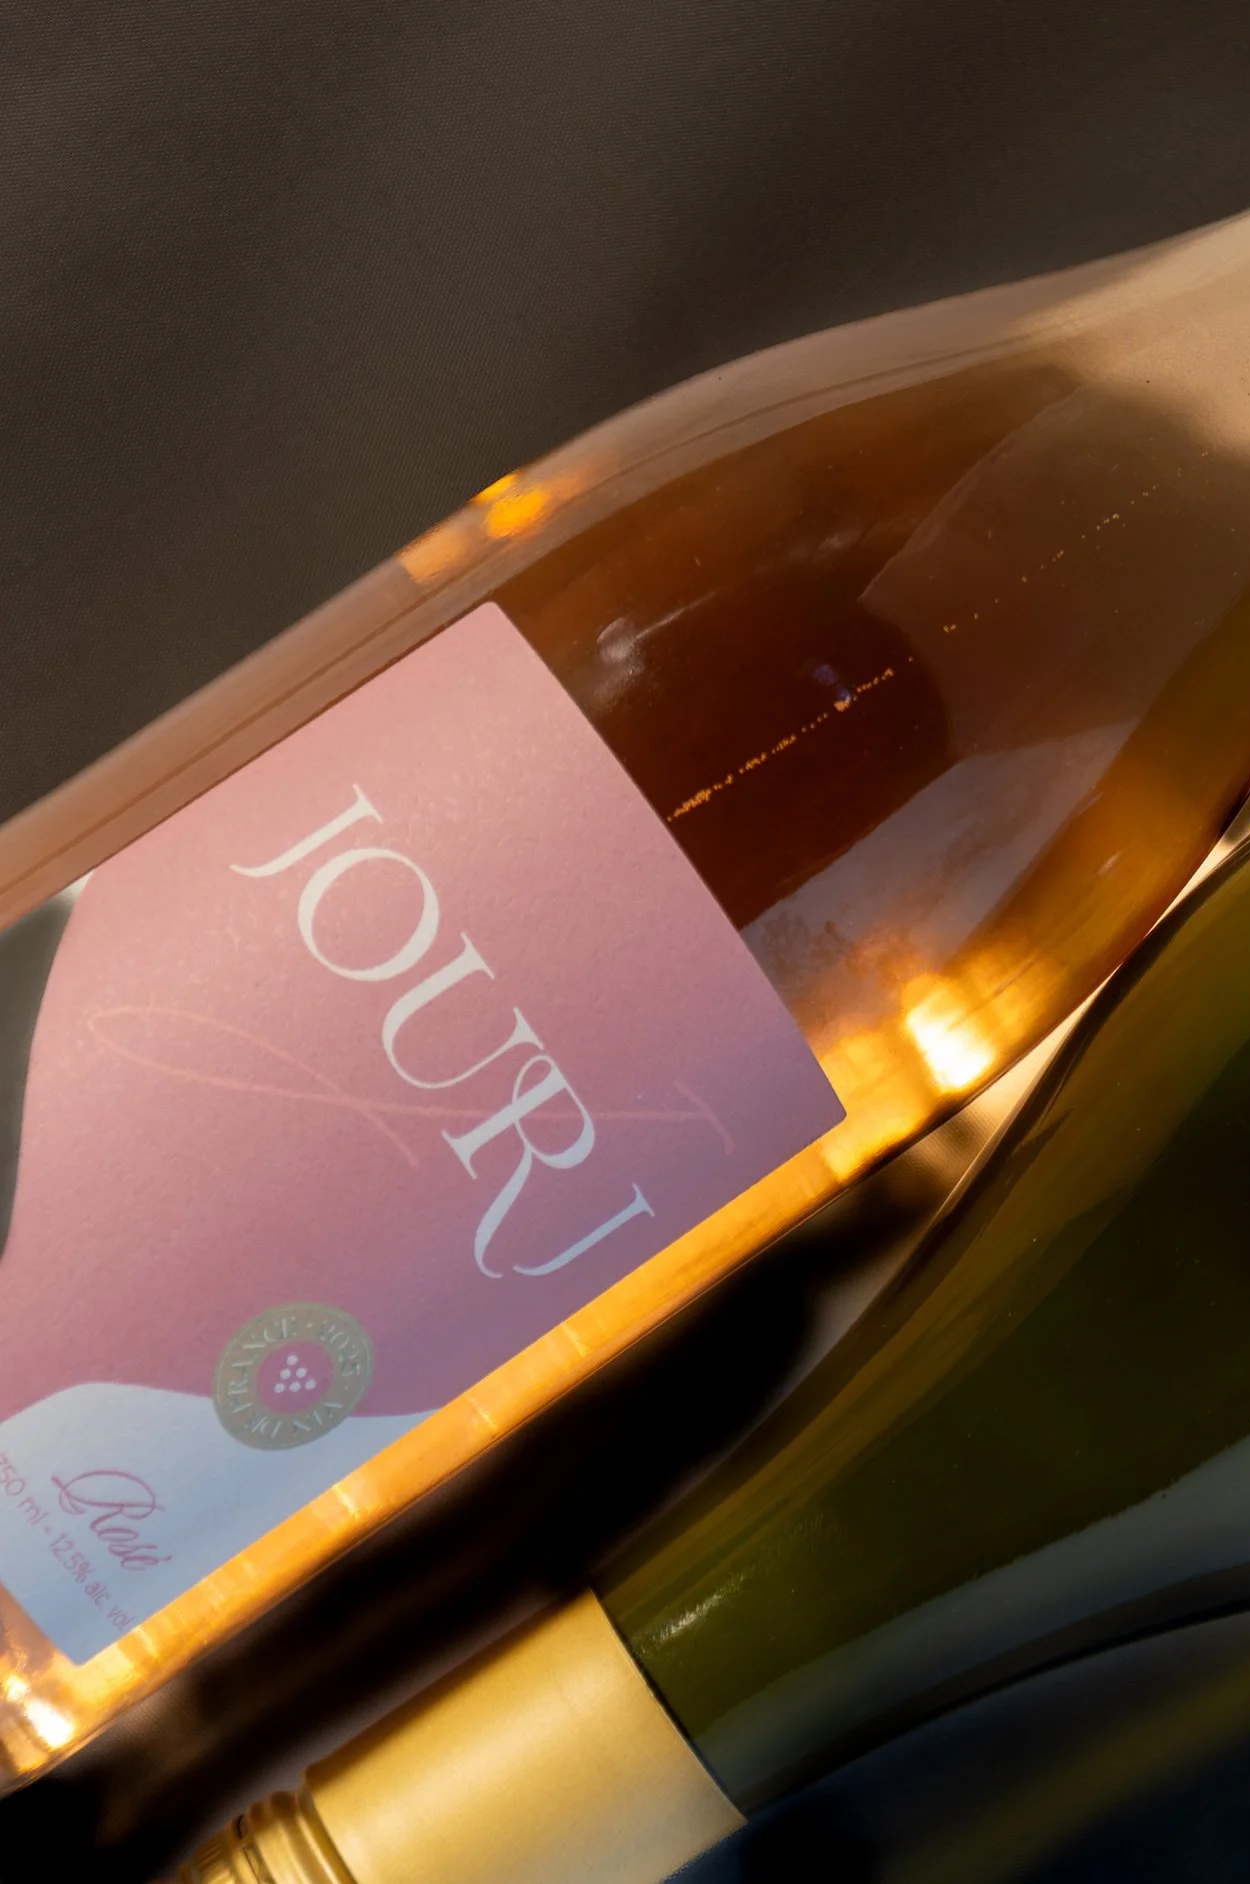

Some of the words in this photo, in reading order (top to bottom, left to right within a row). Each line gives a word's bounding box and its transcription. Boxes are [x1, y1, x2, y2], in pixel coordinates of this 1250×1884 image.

[227, 1316, 297, 1414] FRANCE
[293, 1402, 343, 1436] VIN
[17, 1497, 49, 1526] ml
[50, 1533, 95, 1583] 12.5%
[51, 1470, 173, 1571] Rosé
